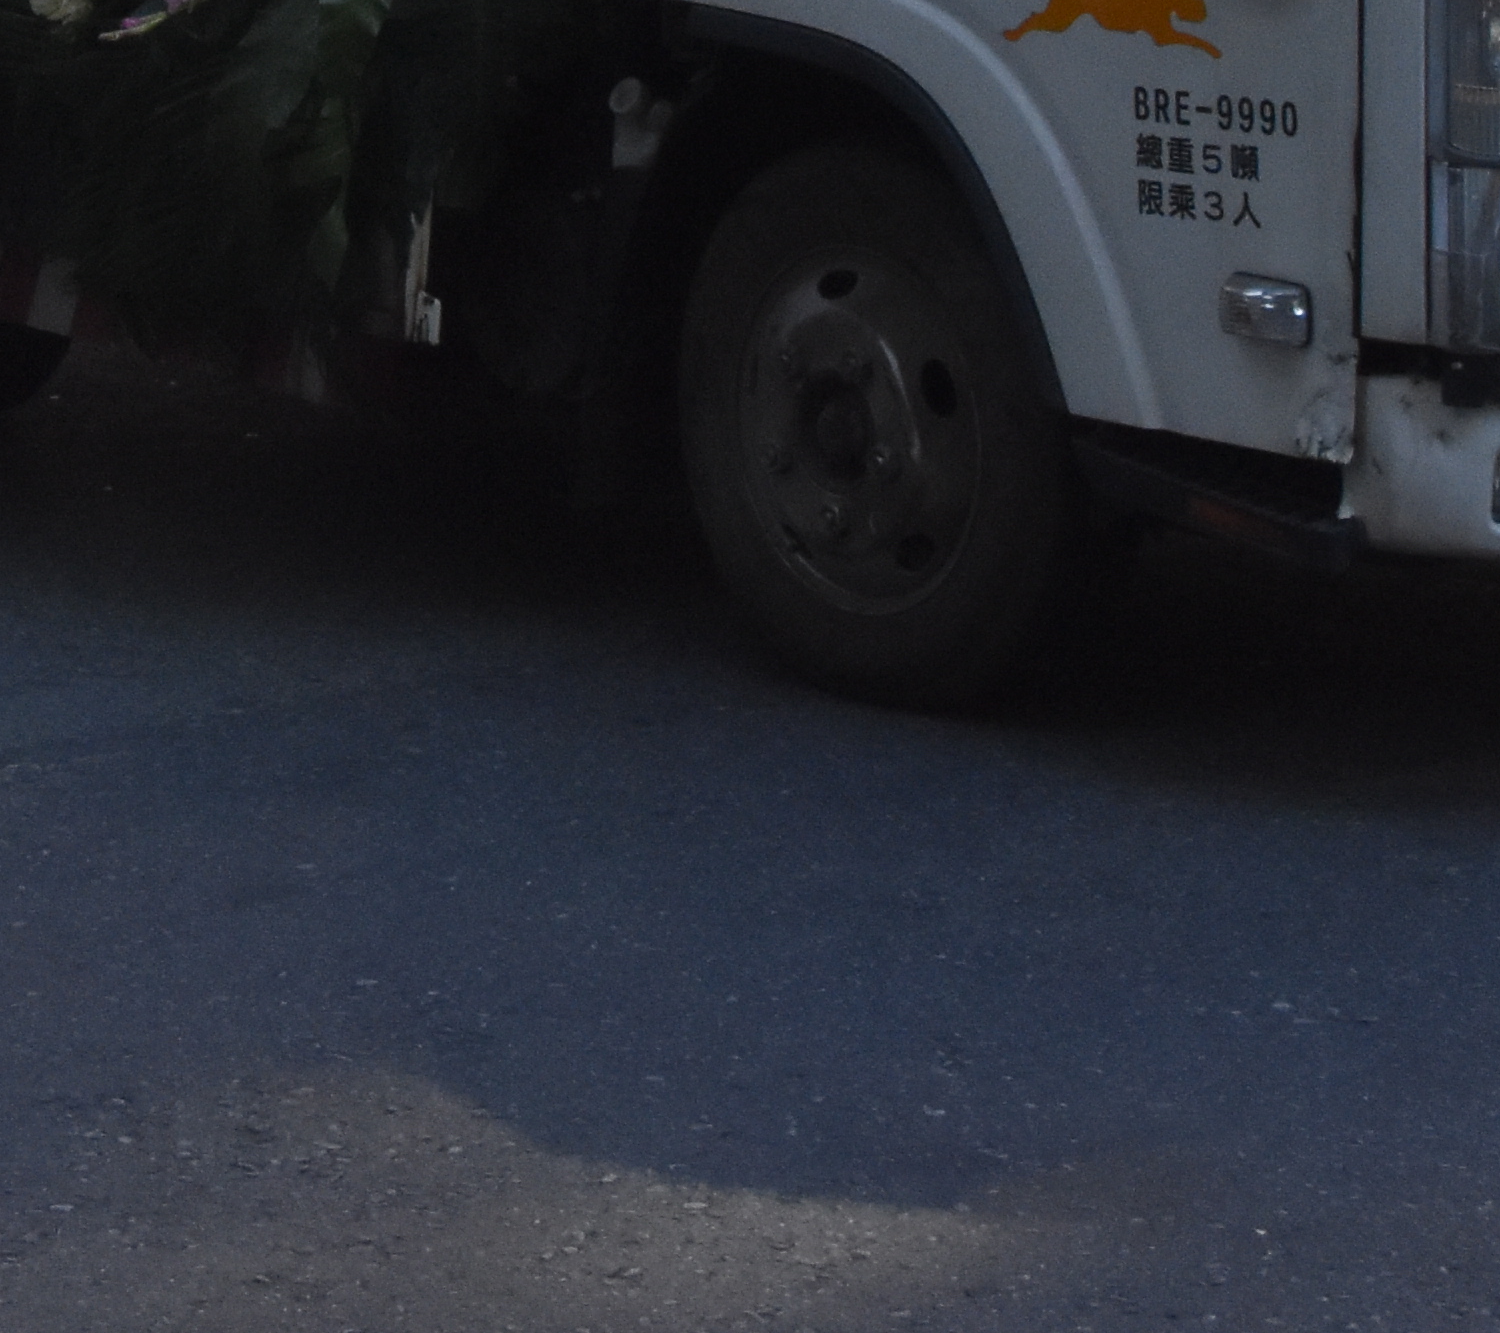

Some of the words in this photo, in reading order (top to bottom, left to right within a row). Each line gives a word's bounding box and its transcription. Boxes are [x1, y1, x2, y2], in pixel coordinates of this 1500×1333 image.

[1134, 86, 1298, 137] BRE-9990
[1138, 179, 1261, 228] 限乘3人
